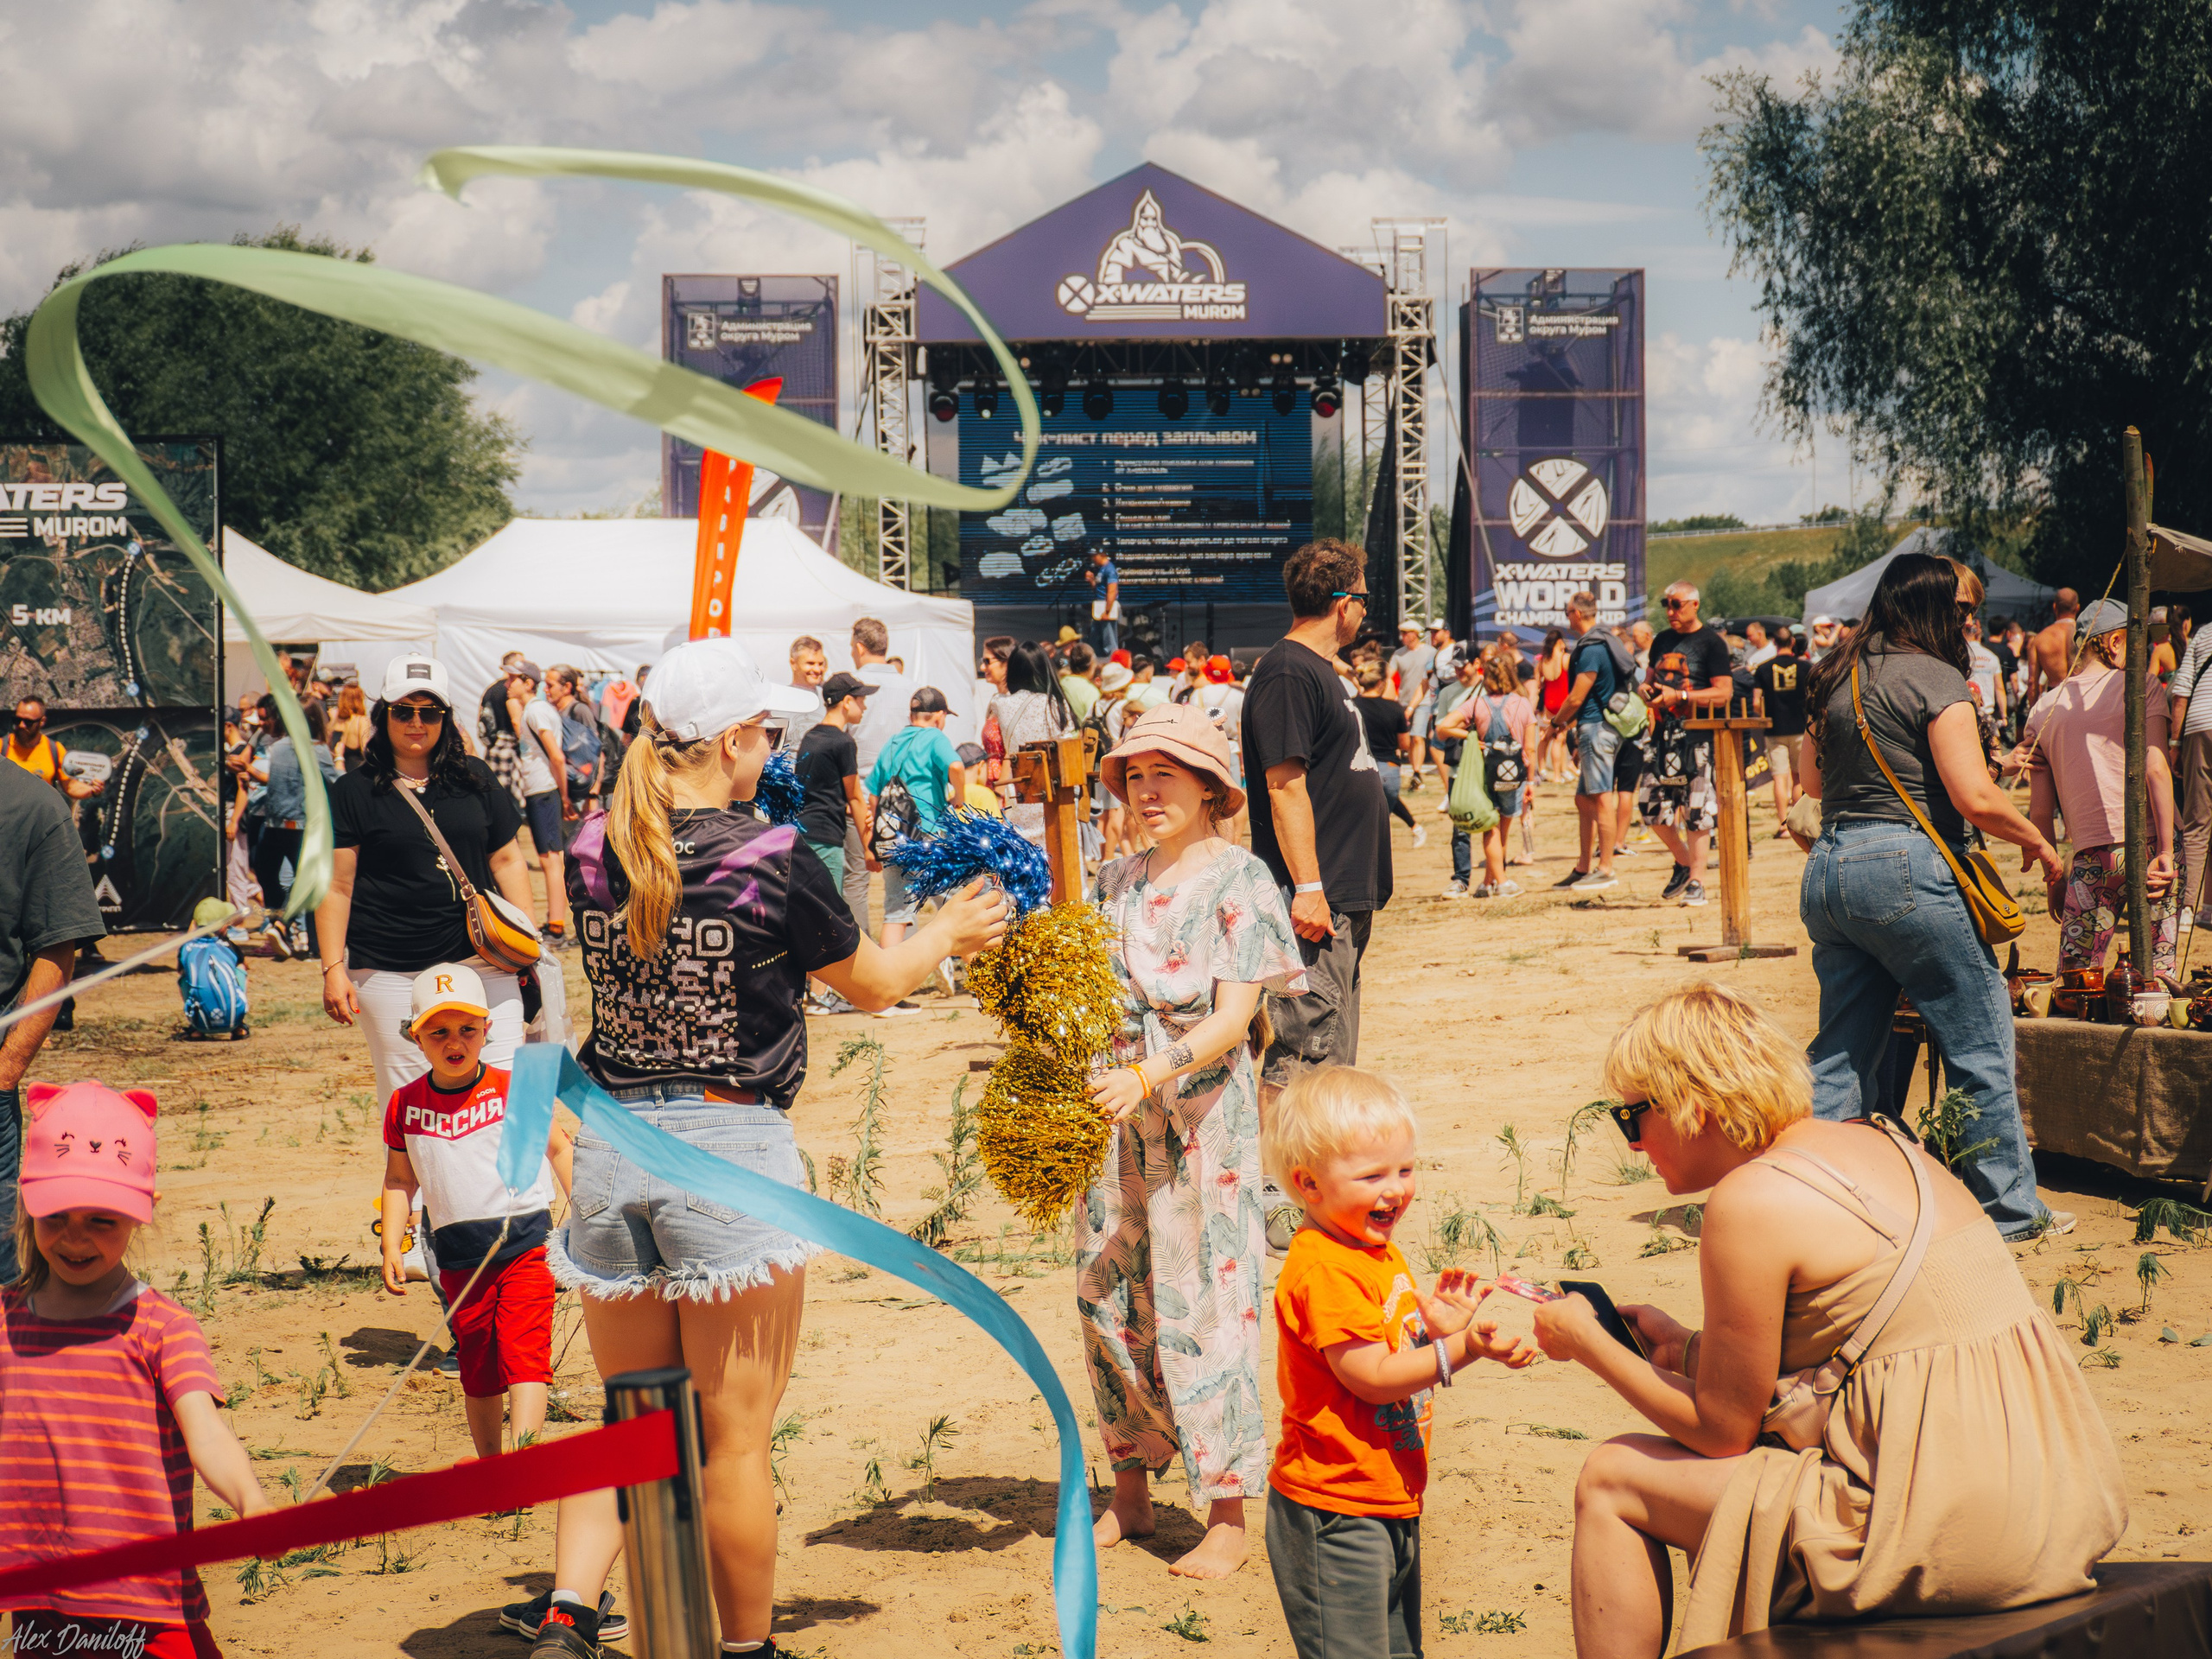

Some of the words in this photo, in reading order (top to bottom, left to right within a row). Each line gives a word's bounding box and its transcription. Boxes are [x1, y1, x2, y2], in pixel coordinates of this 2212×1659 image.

[1183, 305, 1245, 320] MUROM
[1528, 315, 1618, 326] Администрация
[721, 321, 812, 332] Администрация
[1528, 325, 1567, 336] округа
[1568, 325, 1607, 336] Муром
[721, 332, 760, 343] округа
[760, 331, 800, 343] Муром
[1014, 431, 1096, 444] Чк-лист
[1102, 432, 1159, 448] перед
[1162, 431, 1257, 444] заплывом
[34, 516, 127, 537] MUROM
[12, 603, 29, 626] 5
[1495, 610, 1626, 626] CHAMPIHIP
[434, 974, 455, 995] R
[404, 1096, 504, 1138] РОССИЯ
